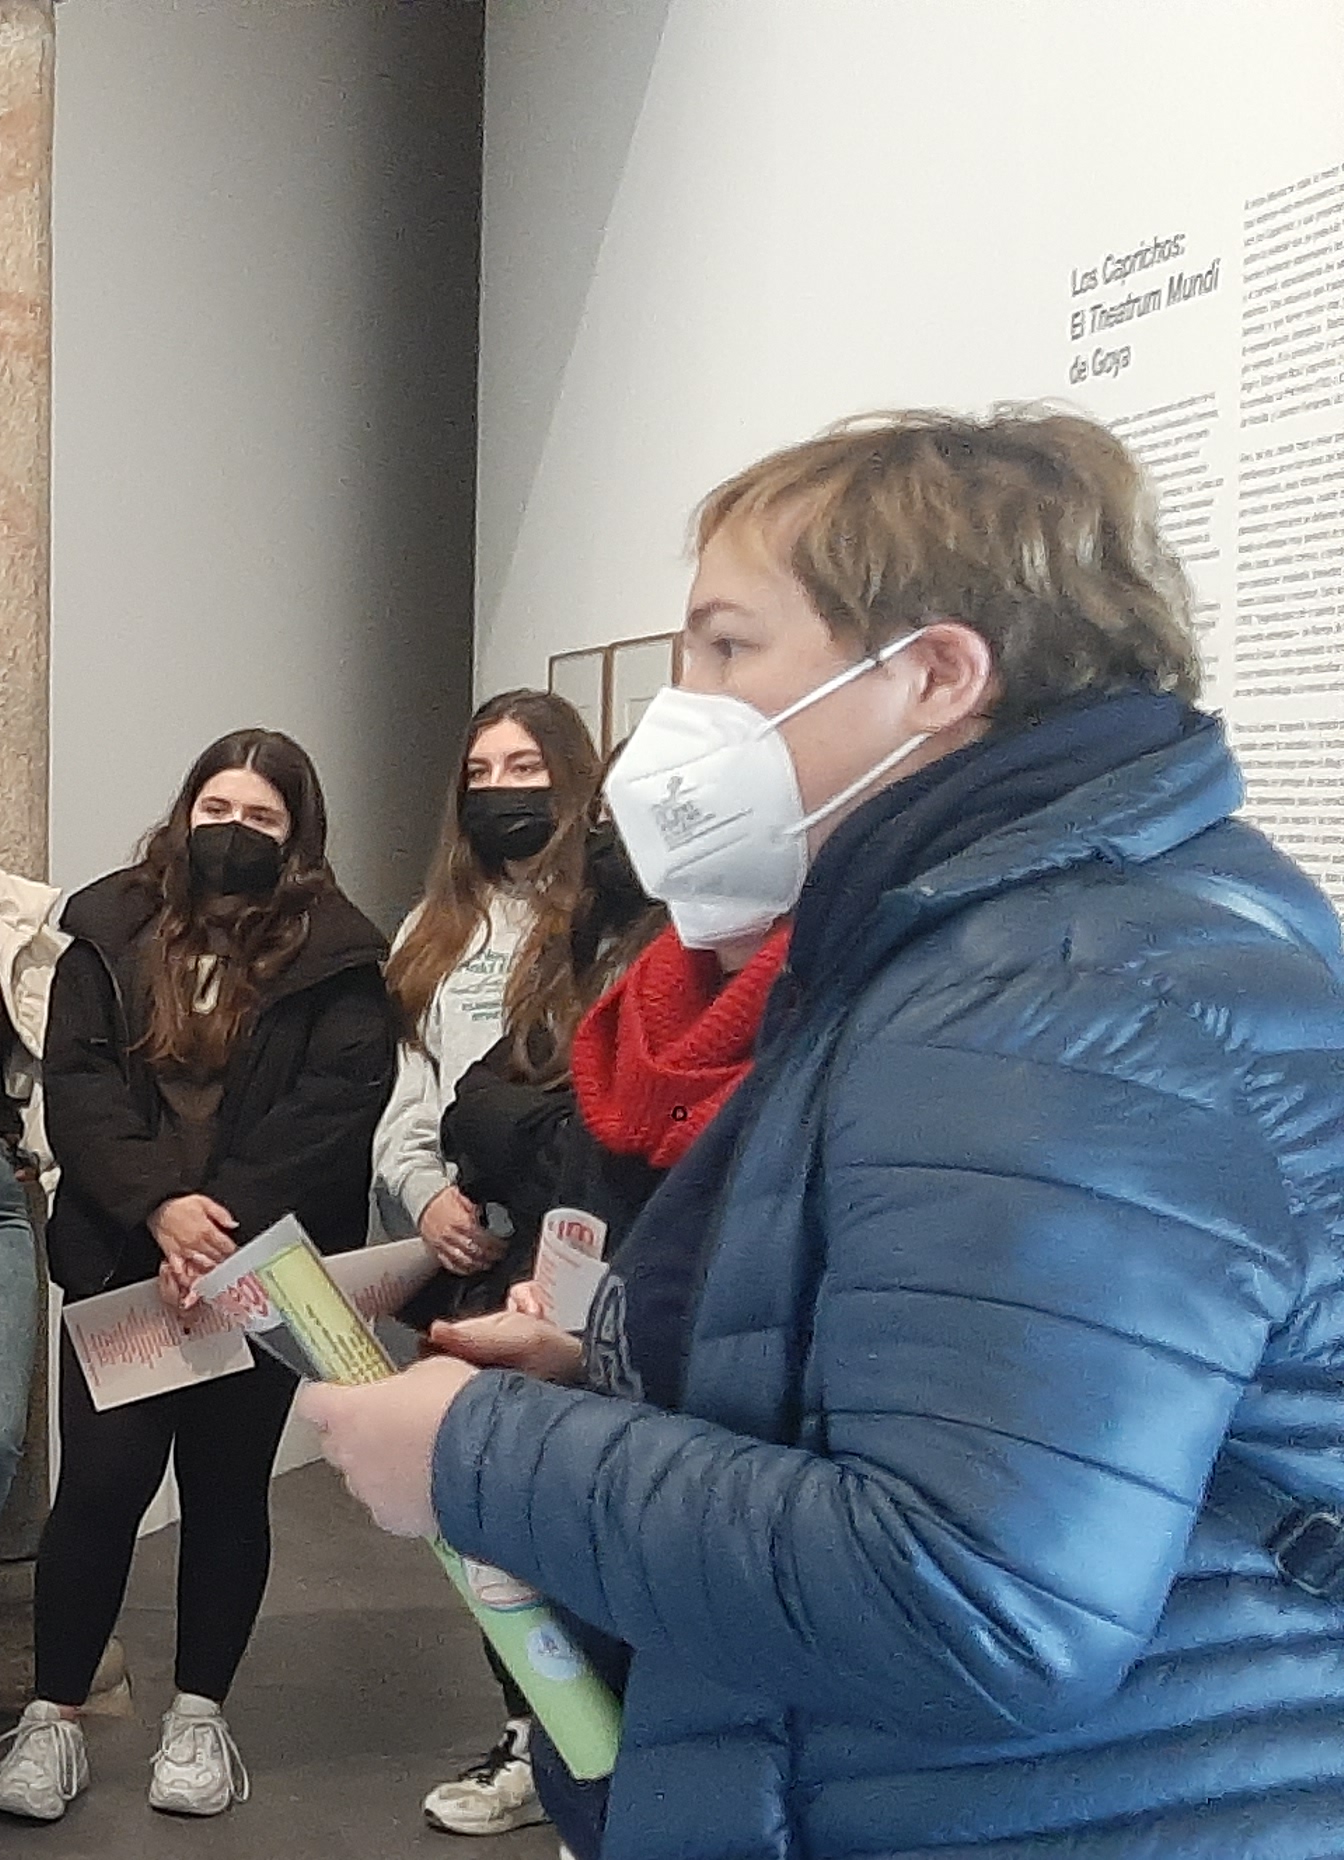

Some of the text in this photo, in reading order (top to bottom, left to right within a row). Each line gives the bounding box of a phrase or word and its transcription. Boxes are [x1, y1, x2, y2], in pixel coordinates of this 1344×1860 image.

[1071, 309, 1085, 341] El
[1166, 257, 1221, 307] Mundi
[1069, 345, 1131, 385] de Goya
